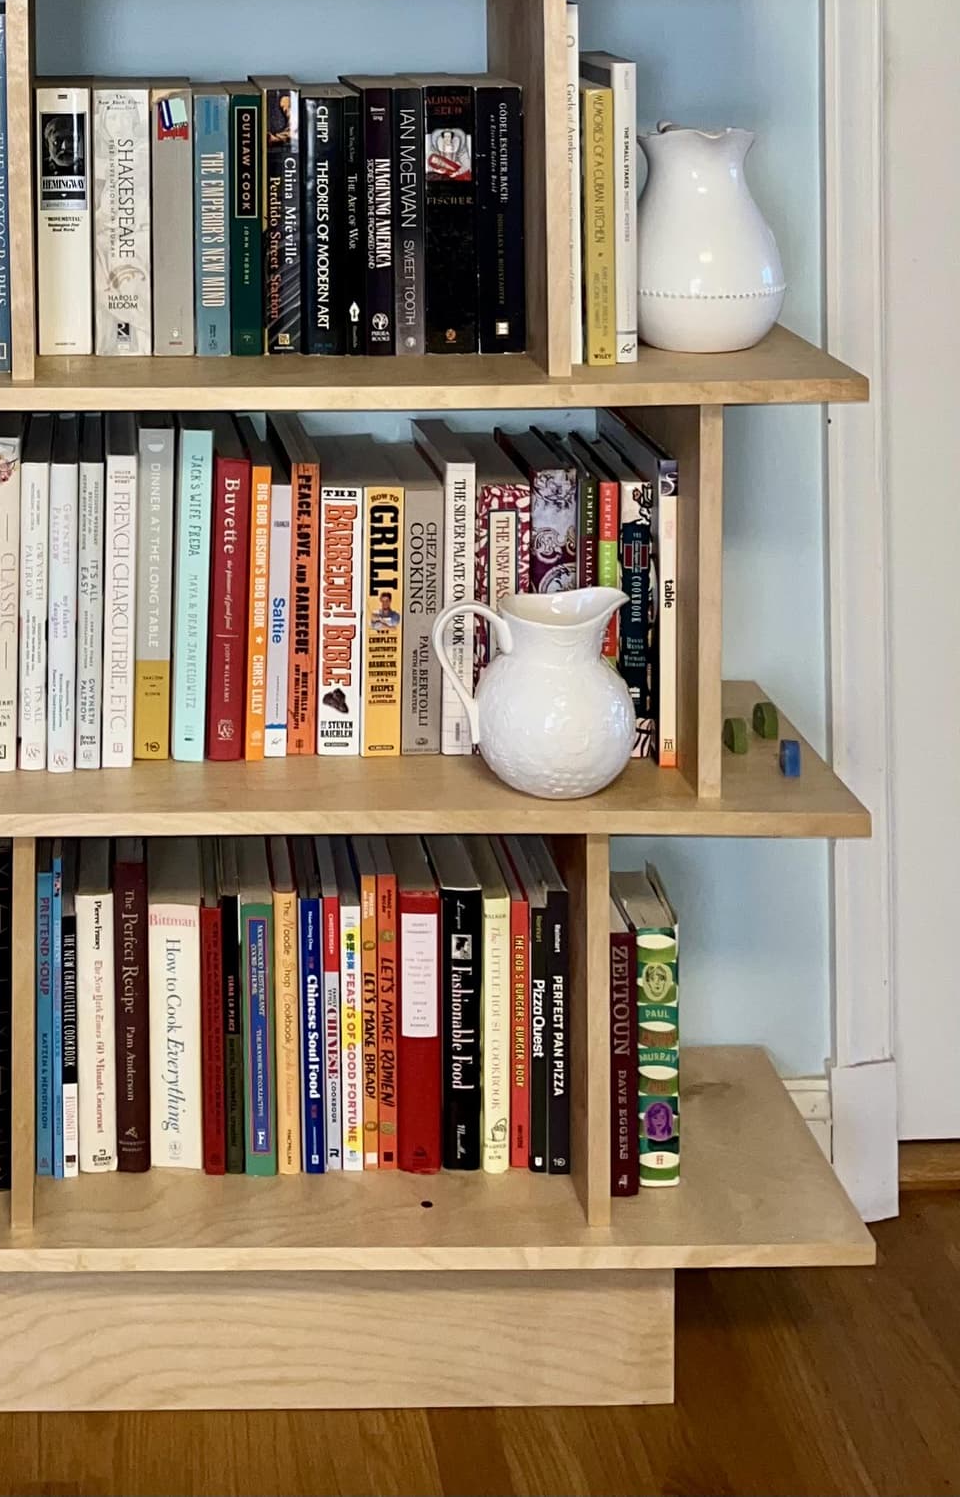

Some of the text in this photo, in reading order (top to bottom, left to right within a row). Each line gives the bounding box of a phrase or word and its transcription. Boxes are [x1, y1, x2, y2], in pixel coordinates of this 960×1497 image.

[117, 139, 135, 258] SHAKESPEARE
[241, 113, 251, 211] OUTLAW COOK
[399, 109, 416, 227] IAN McEWAN
[316, 106, 329, 330] CHIPP THEORIES OF MODERN ART
[223, 478, 240, 554] Buvette
[369, 505, 399, 596] GRILL
[409, 522, 423, 614] COOKING
[426, 522, 437, 615] CHEZ PANISSE
[664, 579, 674, 608] table
[271, 597, 285, 644] Saltie
[322, 624, 356, 686] BIBLE
[161, 938, 186, 1133] How to Cook Everything
[532, 979, 545, 1058] Pizza Quest
[553, 976, 564, 1096] PERFECT PAN PIZZA
[612, 946, 630, 1160] ZEITOUN DAVE EGGERS
